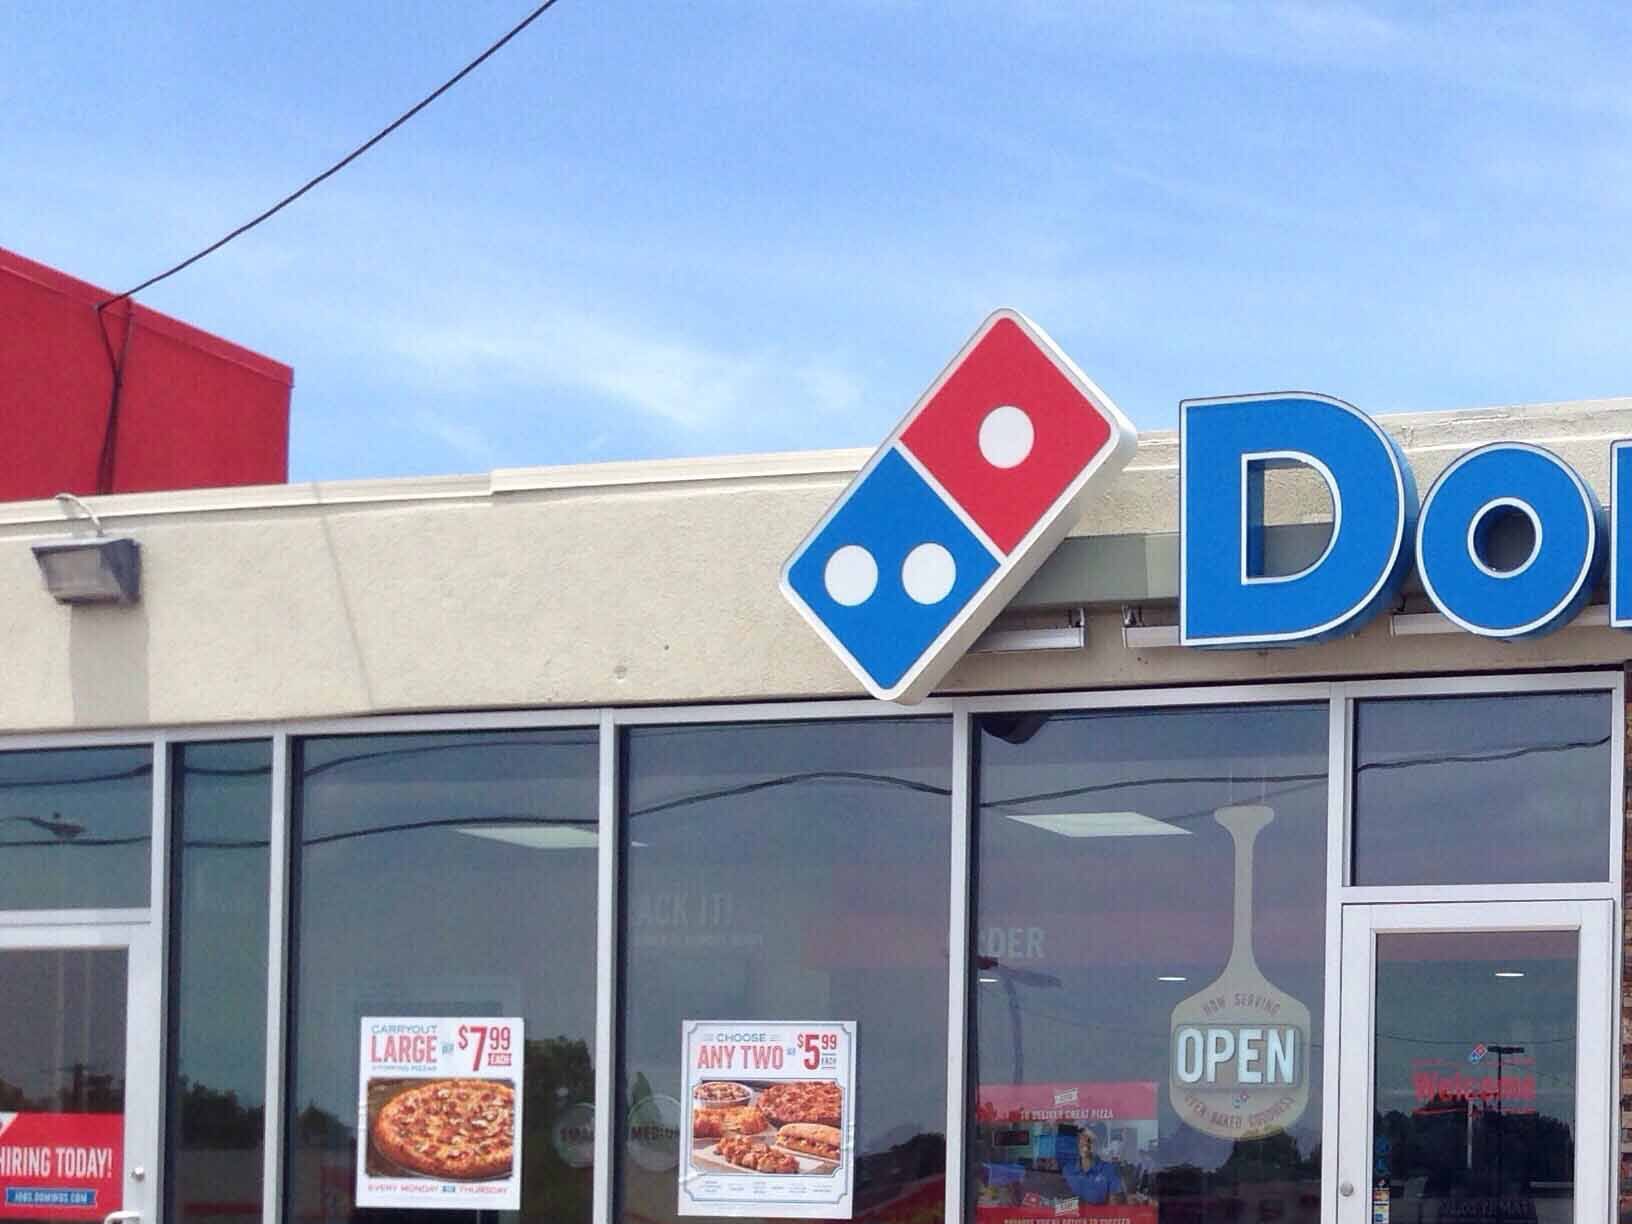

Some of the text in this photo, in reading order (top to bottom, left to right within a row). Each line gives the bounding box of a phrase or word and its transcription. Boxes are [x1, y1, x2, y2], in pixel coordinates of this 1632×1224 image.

[371, 1024, 437, 1034] CARRYOUT
[716, 1032, 767, 1043] CHOOSE
[370, 1035, 438, 1064] LARGE
[697, 1045, 736, 1070] ANY
[740, 1045, 784, 1070] TWO
[1177, 1027, 1297, 1084] OPEN
[55, 1147, 113, 1179] TODAY!
